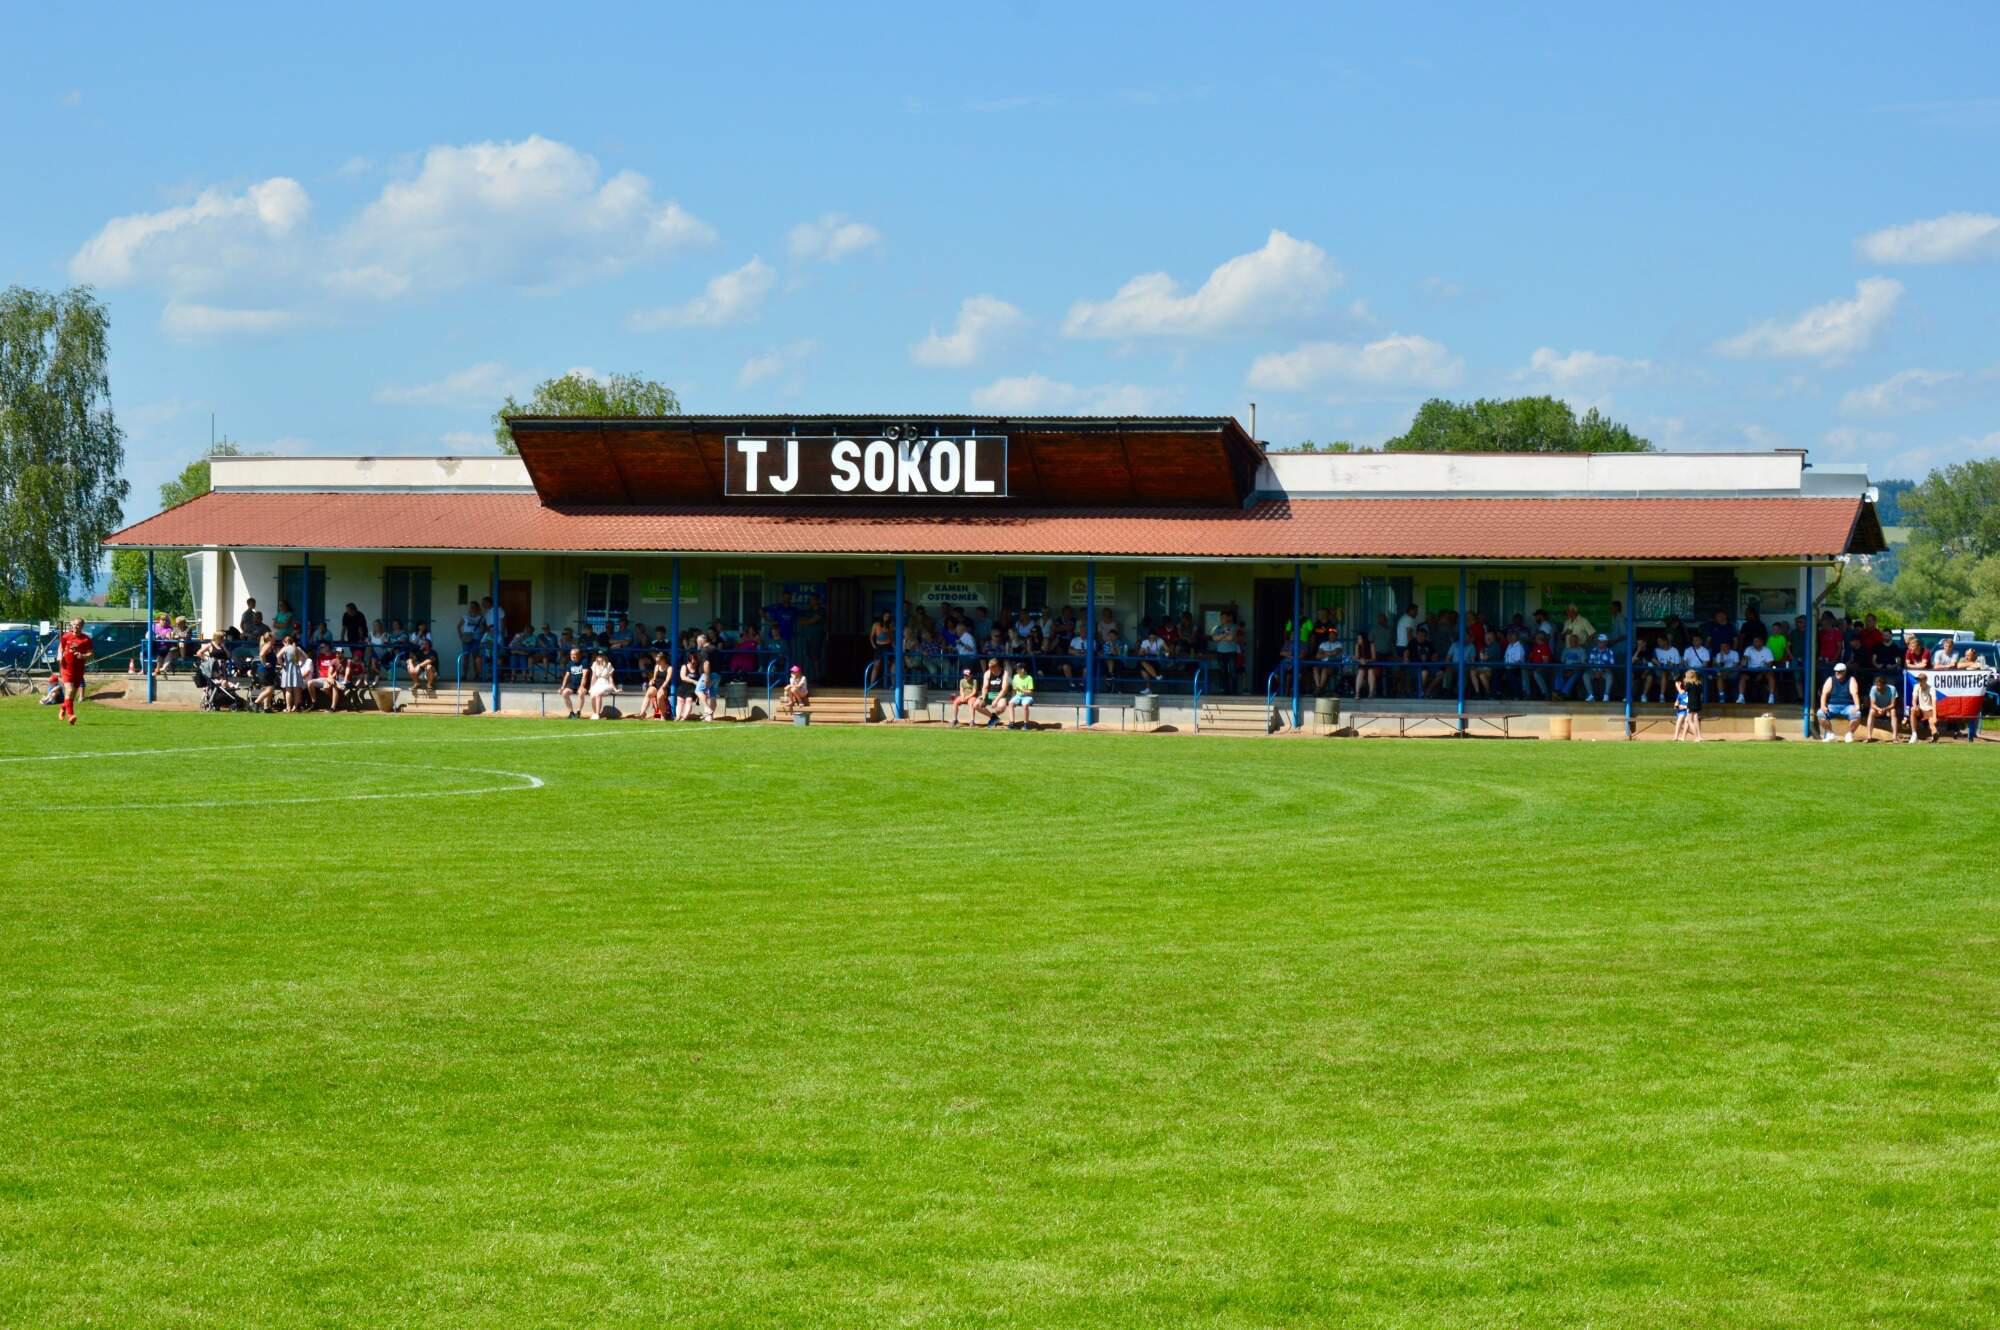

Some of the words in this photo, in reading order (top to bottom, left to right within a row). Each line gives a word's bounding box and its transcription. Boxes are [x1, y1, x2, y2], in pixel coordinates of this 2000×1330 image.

[737, 440, 799, 492] TJ
[830, 440, 995, 493] SOKOL
[1934, 674, 1988, 688] CHOMUTICE
